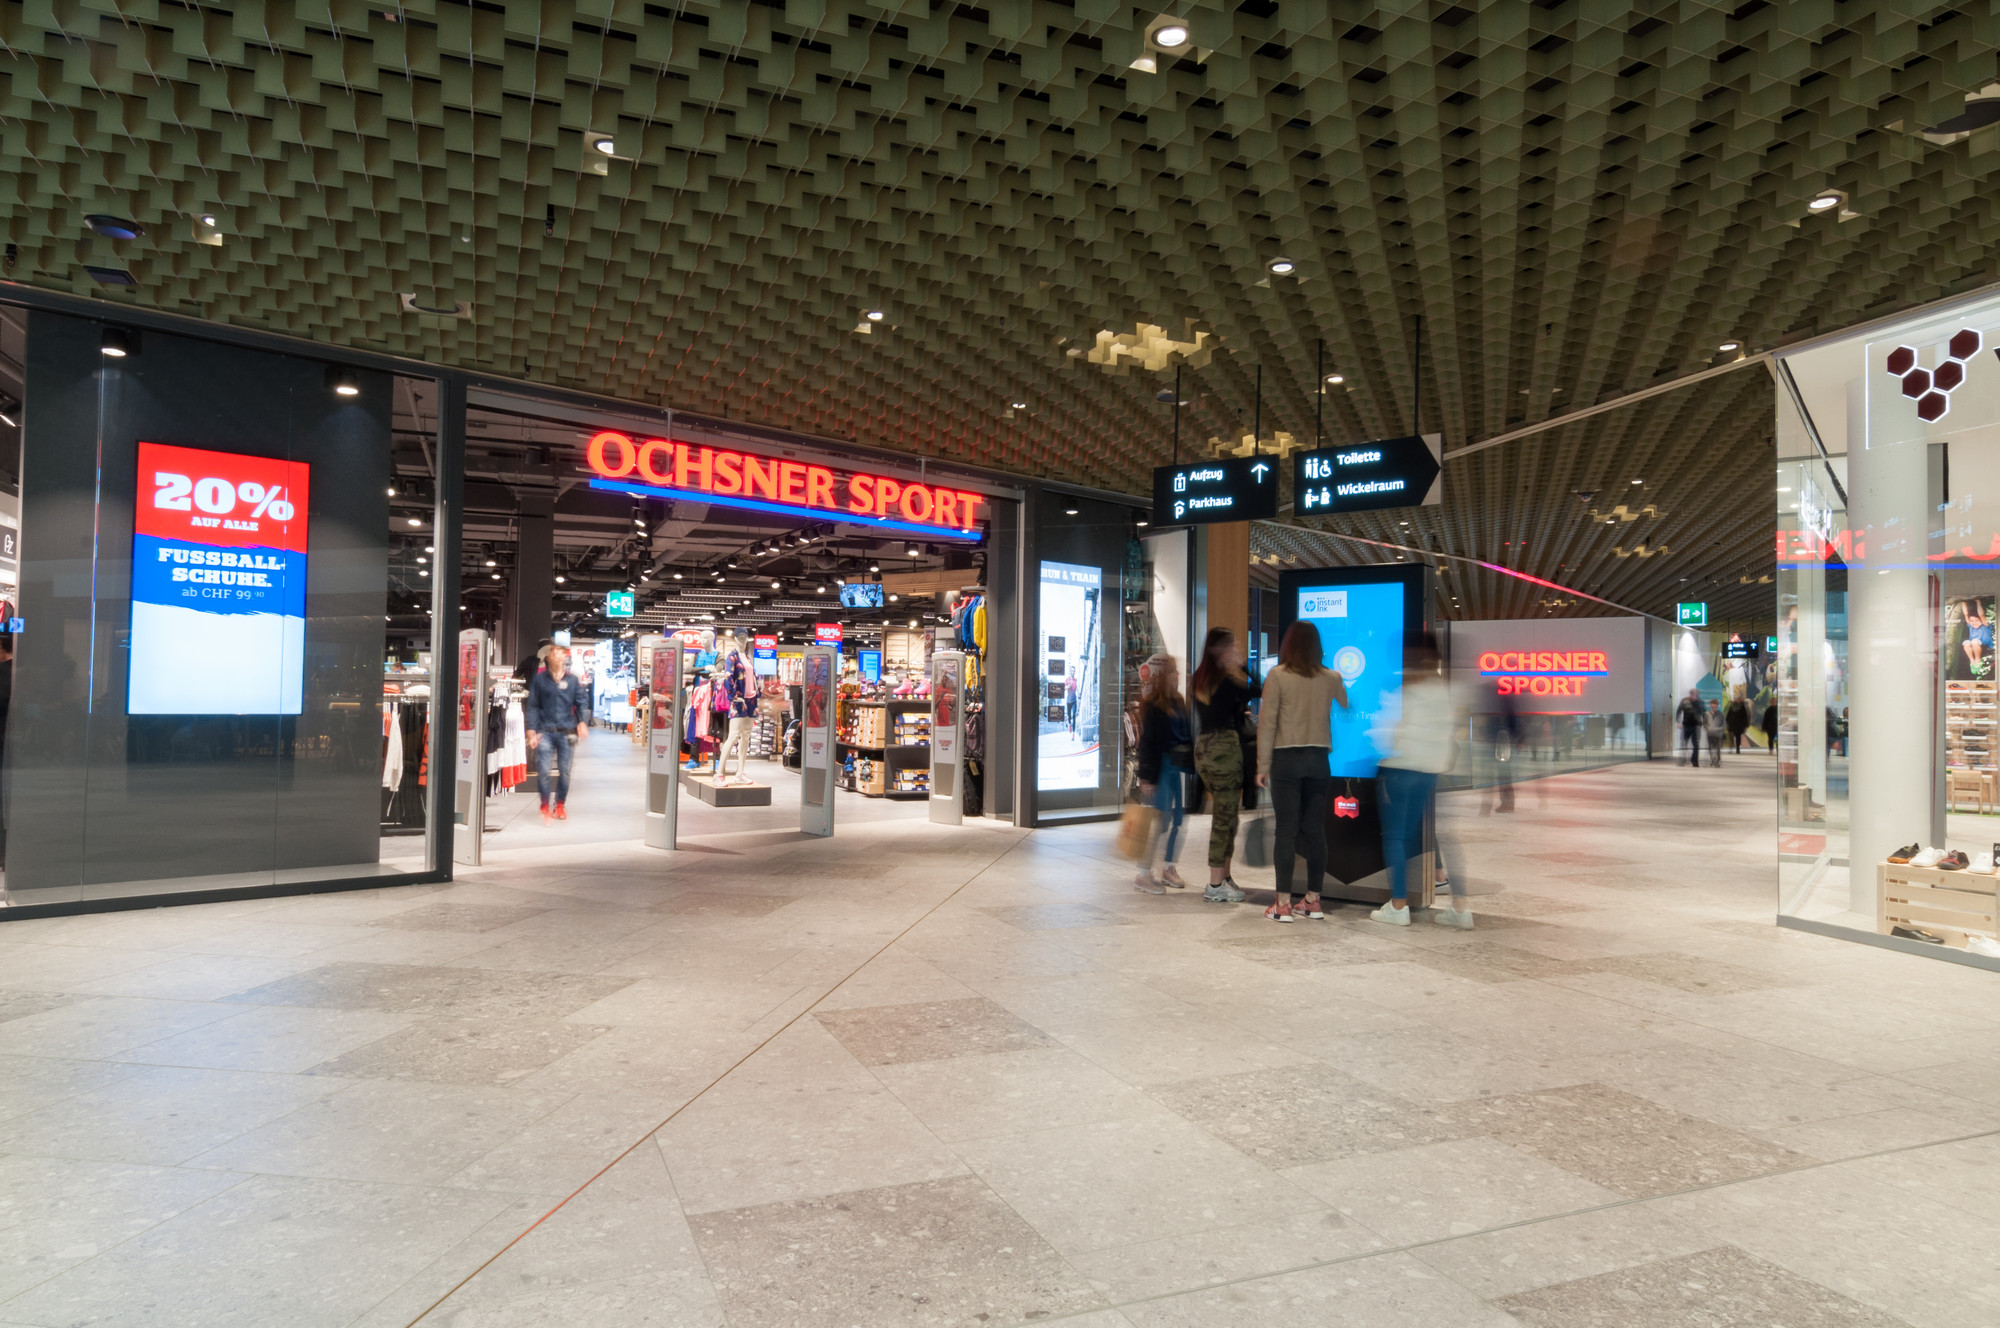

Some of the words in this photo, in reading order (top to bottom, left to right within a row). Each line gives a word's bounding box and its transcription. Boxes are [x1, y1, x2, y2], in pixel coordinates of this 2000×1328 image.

[1337, 451, 1381, 466] Toilette
[587, 432, 837, 509] OCHSNER
[849, 475, 983, 529] SPORT
[1189, 469, 1223, 482] Aufzug
[1337, 480, 1405, 496] Wickelraum
[154, 472, 295, 521] 20%
[1189, 496, 1233, 509] Parkhaus
[190, 516, 221, 528] AUF
[223, 519, 259, 531] ALLE
[158, 547, 286, 571] FUSSBALL-
[172, 567, 273, 588] SCHUHE.
[1040, 567, 1060, 579] RUN
[1062, 570, 1069, 580] &
[1070, 571, 1099, 583] TRAIN
[181, 587, 198, 598] ab
[202, 588, 232, 599] CHF
[1479, 651, 1608, 672] OCHSNER
[1497, 676, 1588, 696] SPORT
